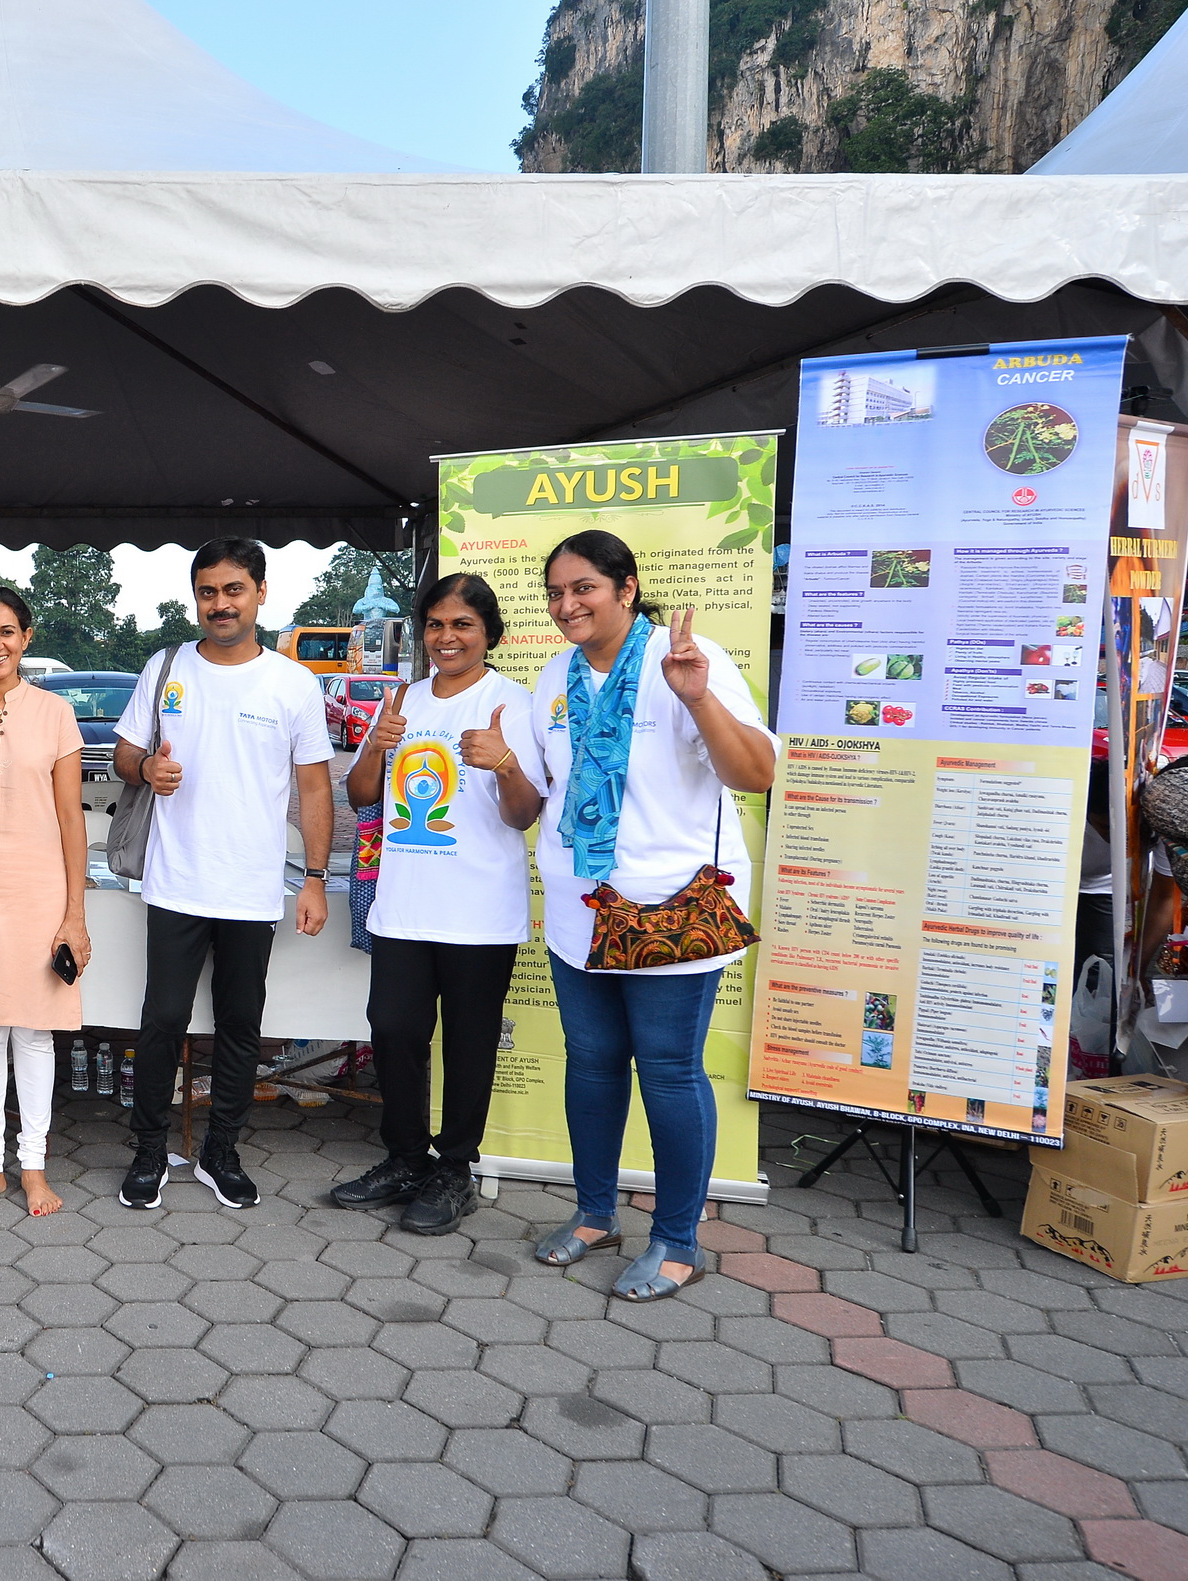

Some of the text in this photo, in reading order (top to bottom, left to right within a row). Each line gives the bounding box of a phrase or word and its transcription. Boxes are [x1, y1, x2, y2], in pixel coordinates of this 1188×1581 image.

[992, 354, 1083, 369] ARBUDA
[997, 370, 1074, 386] CANCER
[525, 465, 680, 506] AYUSH
[460, 539, 527, 551] AYURVEDA
[1110, 536, 1142, 557] HERBAL
[650, 548, 703, 559] originated
[708, 547, 732, 555] from
[460, 556, 505, 567] Ayurveda
[639, 560, 754, 572] listic management of
[493, 568, 519, 578] (5000
[650, 575, 706, 584] medicines
[716, 574, 733, 582] act
[1130, 570, 1161, 590] POWDER
[518, 593, 538, 601] with
[673, 589, 701, 599] (Vata,
[706, 588, 729, 596] Pitta
[733, 587, 752, 595] and
[663, 601, 752, 611] health, physical,
[513, 619, 552, 628] spiritual
[500, 636, 508, 644] &
[507, 651, 547, 660] spiritual
[239, 712, 278, 725] TATA MOTORS
[439, 730, 454, 741] DAY
[789, 737, 804, 746] HIV
[811, 739, 829, 748] AIDS
[837, 740, 880, 750] OJOKSHYA
[940, 759, 996, 769] Ayurvedic Management
[457, 762, 466, 793] YOGA
[844, 797, 873, 805] transmission
[512, 972, 547, 981] edicine
[508, 985, 551, 994] hysician
[726, 984, 742, 993] the
[513, 997, 540, 1006] and is
[782, 1047, 809, 1056] management
[750, 1091, 781, 1101] MINISTRY
[816, 1102, 839, 1111] AYUSH
[907, 1116, 923, 1124] GPO
[924, 1118, 960, 1130] COMPLEX,
[979, 1127, 996, 1135] NEW
[997, 1130, 1020, 1139] DELHI
[1030, 1136, 1060, 1146] 110023
